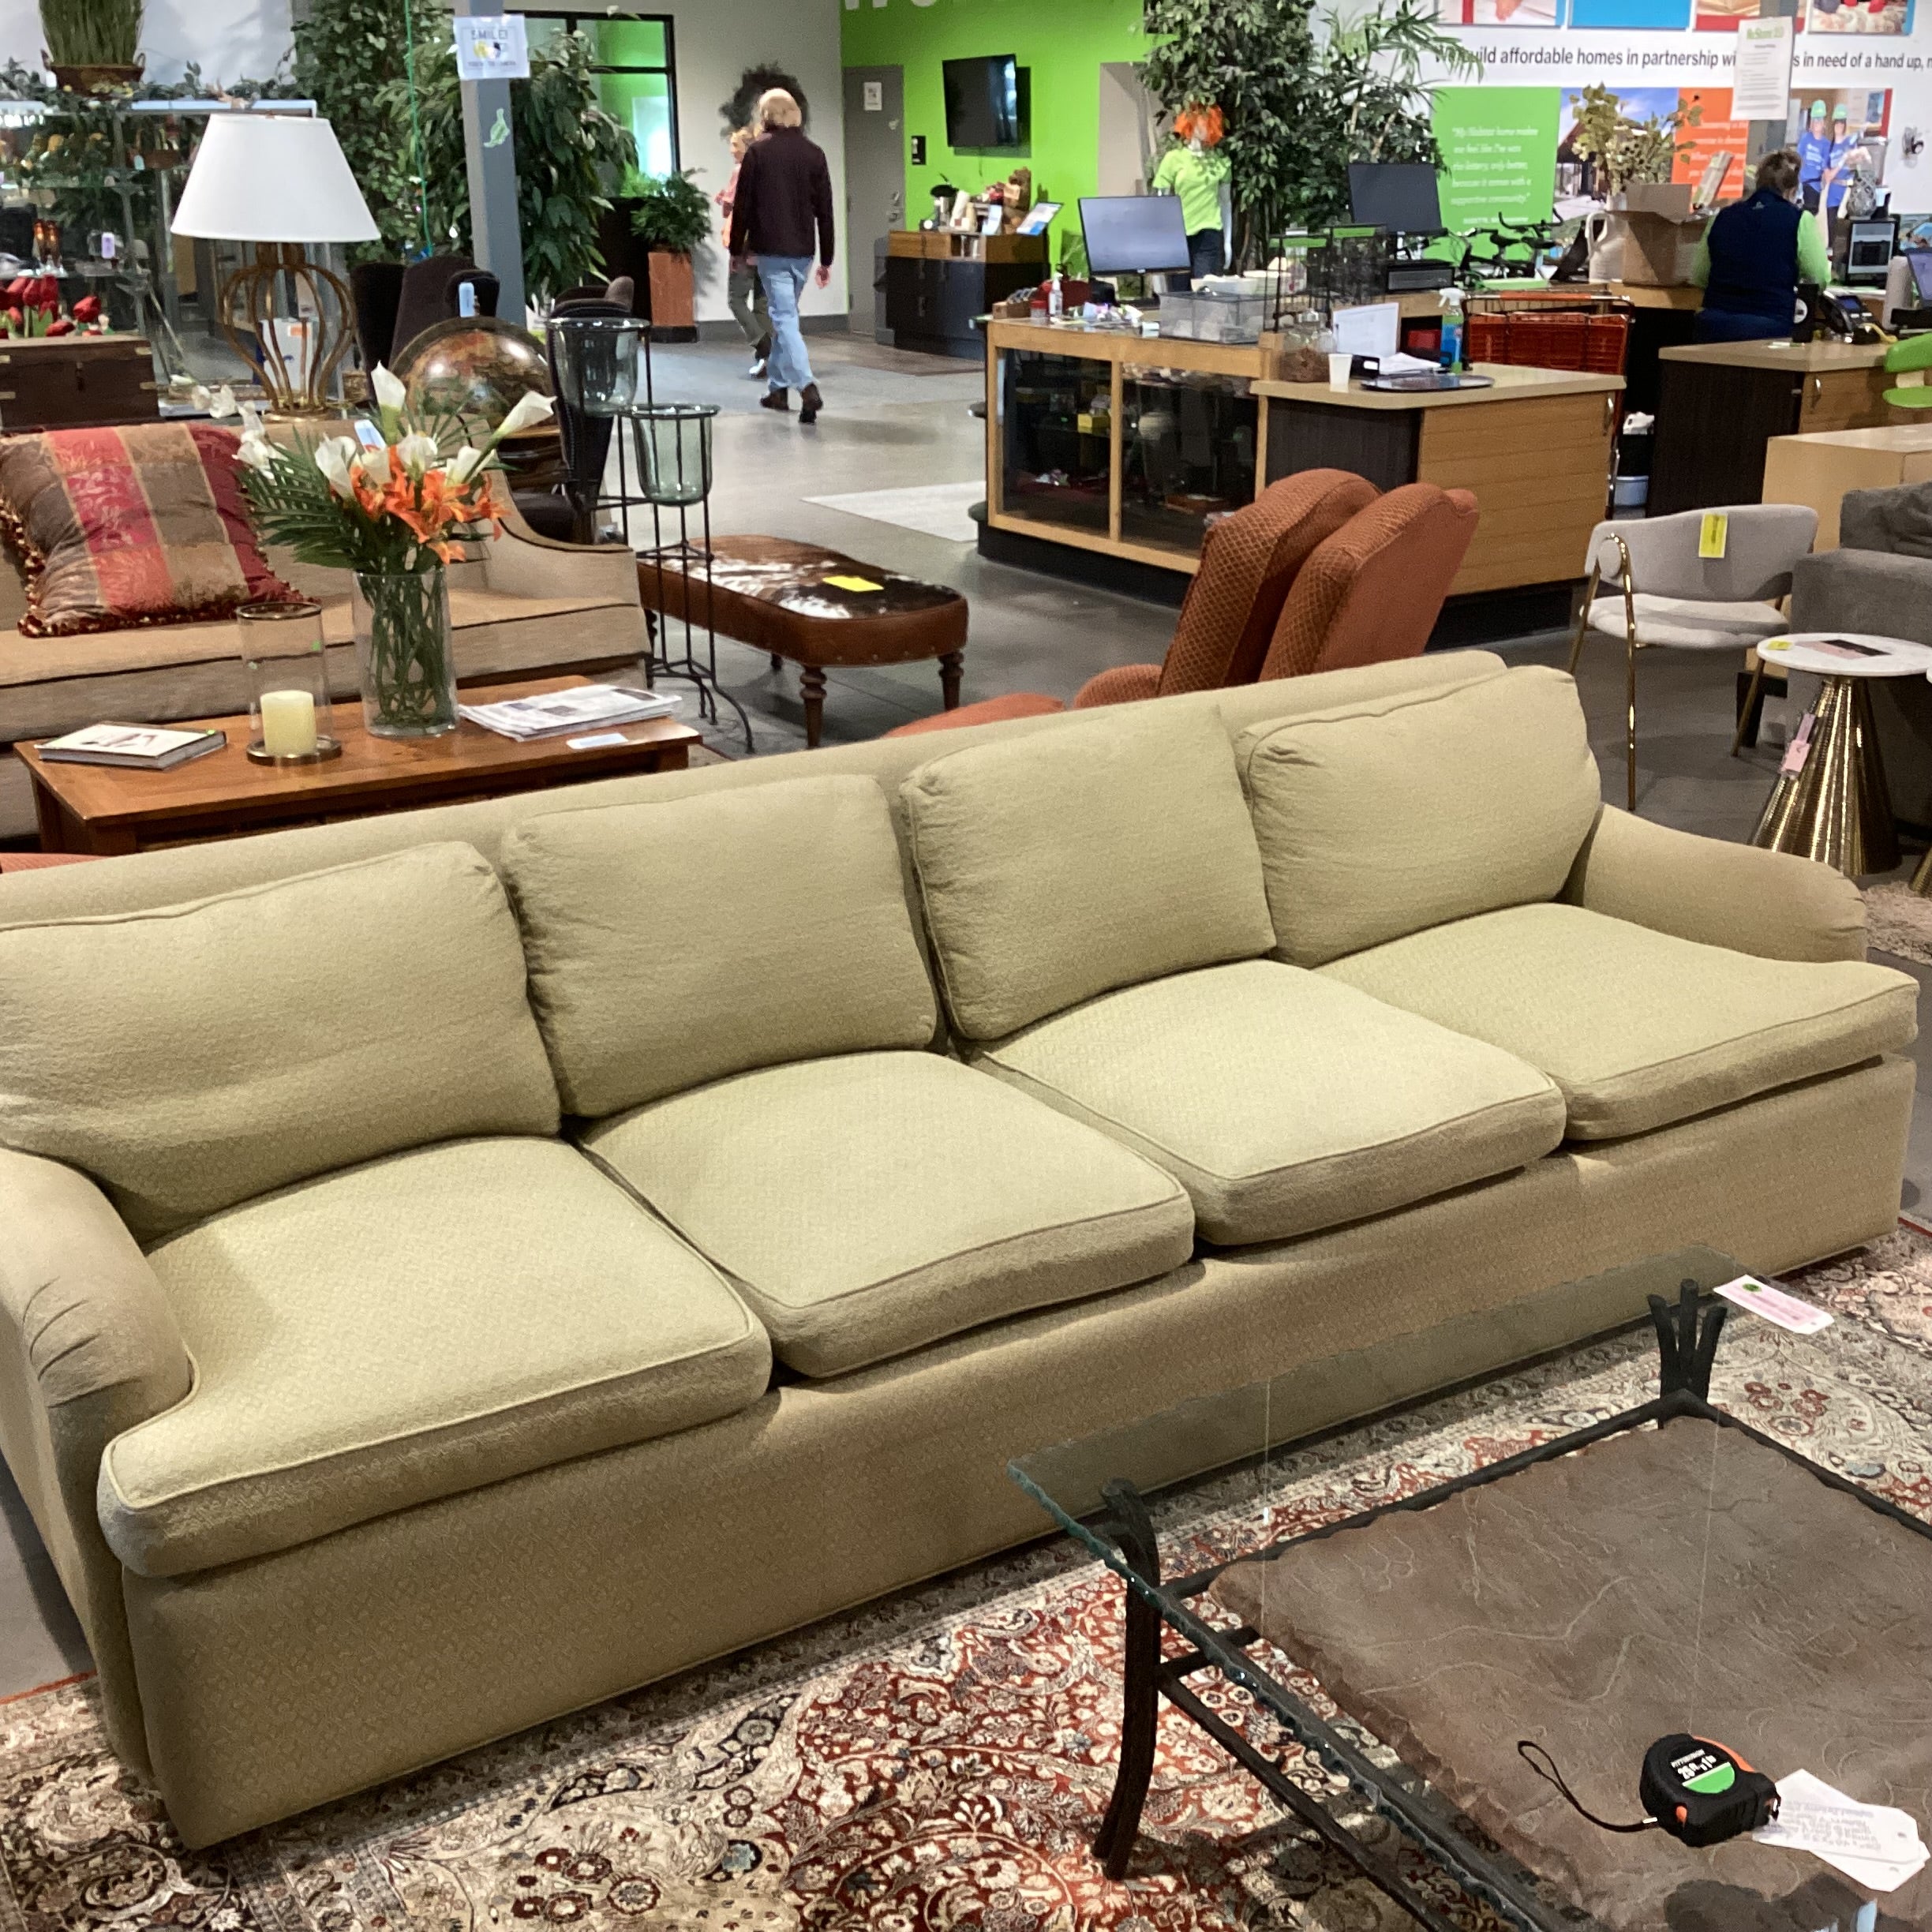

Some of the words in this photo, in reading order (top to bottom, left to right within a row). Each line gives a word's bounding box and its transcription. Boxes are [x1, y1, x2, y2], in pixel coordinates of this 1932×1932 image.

[1463, 46, 1496, 63] uild
[1500, 46, 1573, 64] affordable
[1577, 47, 1623, 66] homes
[1627, 47, 1638, 66] in
[1642, 50, 1719, 69] partnership
[1803, 51, 1814, 67] in
[1817, 52, 1848, 67] need
[1850, 52, 1863, 67] of
[1865, 55, 1872, 68] a
[1874, 52, 1904, 68] hand
[1907, 56, 1923, 71] up,
